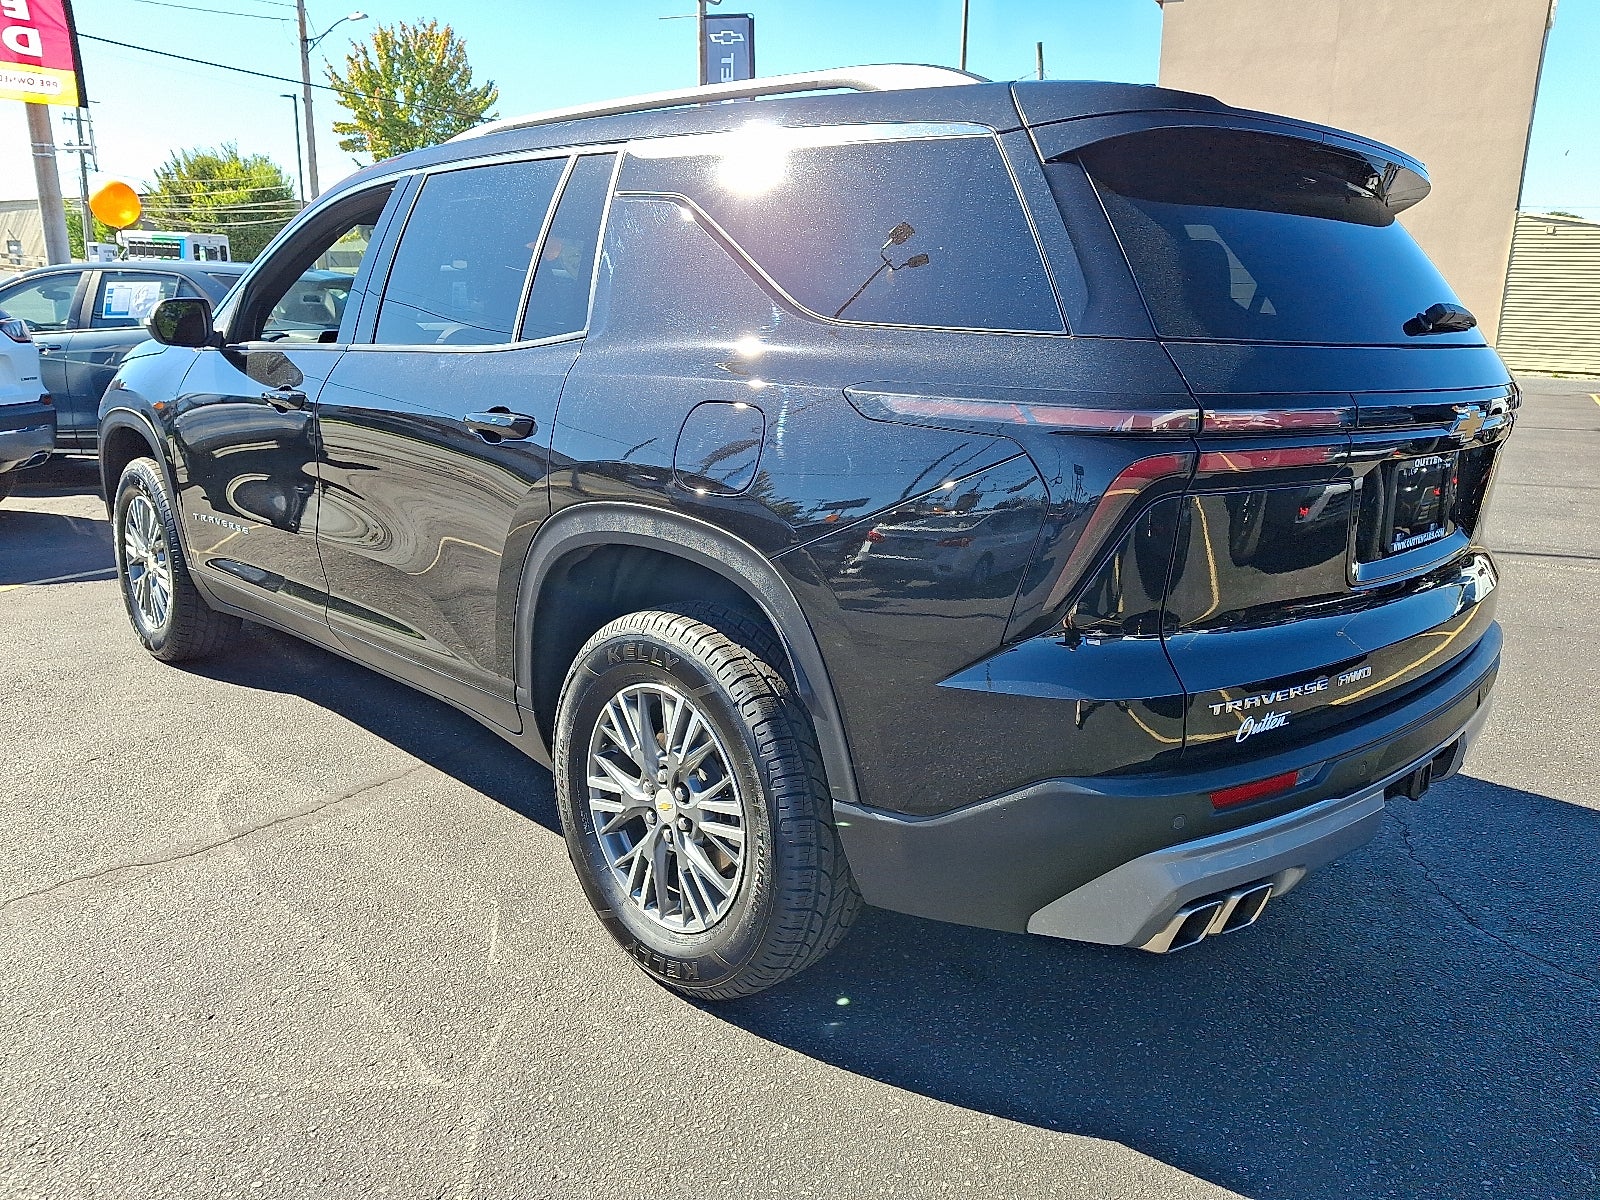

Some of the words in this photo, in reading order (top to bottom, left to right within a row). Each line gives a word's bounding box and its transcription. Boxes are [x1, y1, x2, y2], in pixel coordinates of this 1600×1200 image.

[192, 512, 250, 535] TRAVERSE
[606, 642, 681, 672] KELLY
[1208, 678, 1329, 716] TRAVERSE
[1235, 710, 1292, 743] Outten
[625, 938, 700, 981] KELLY
